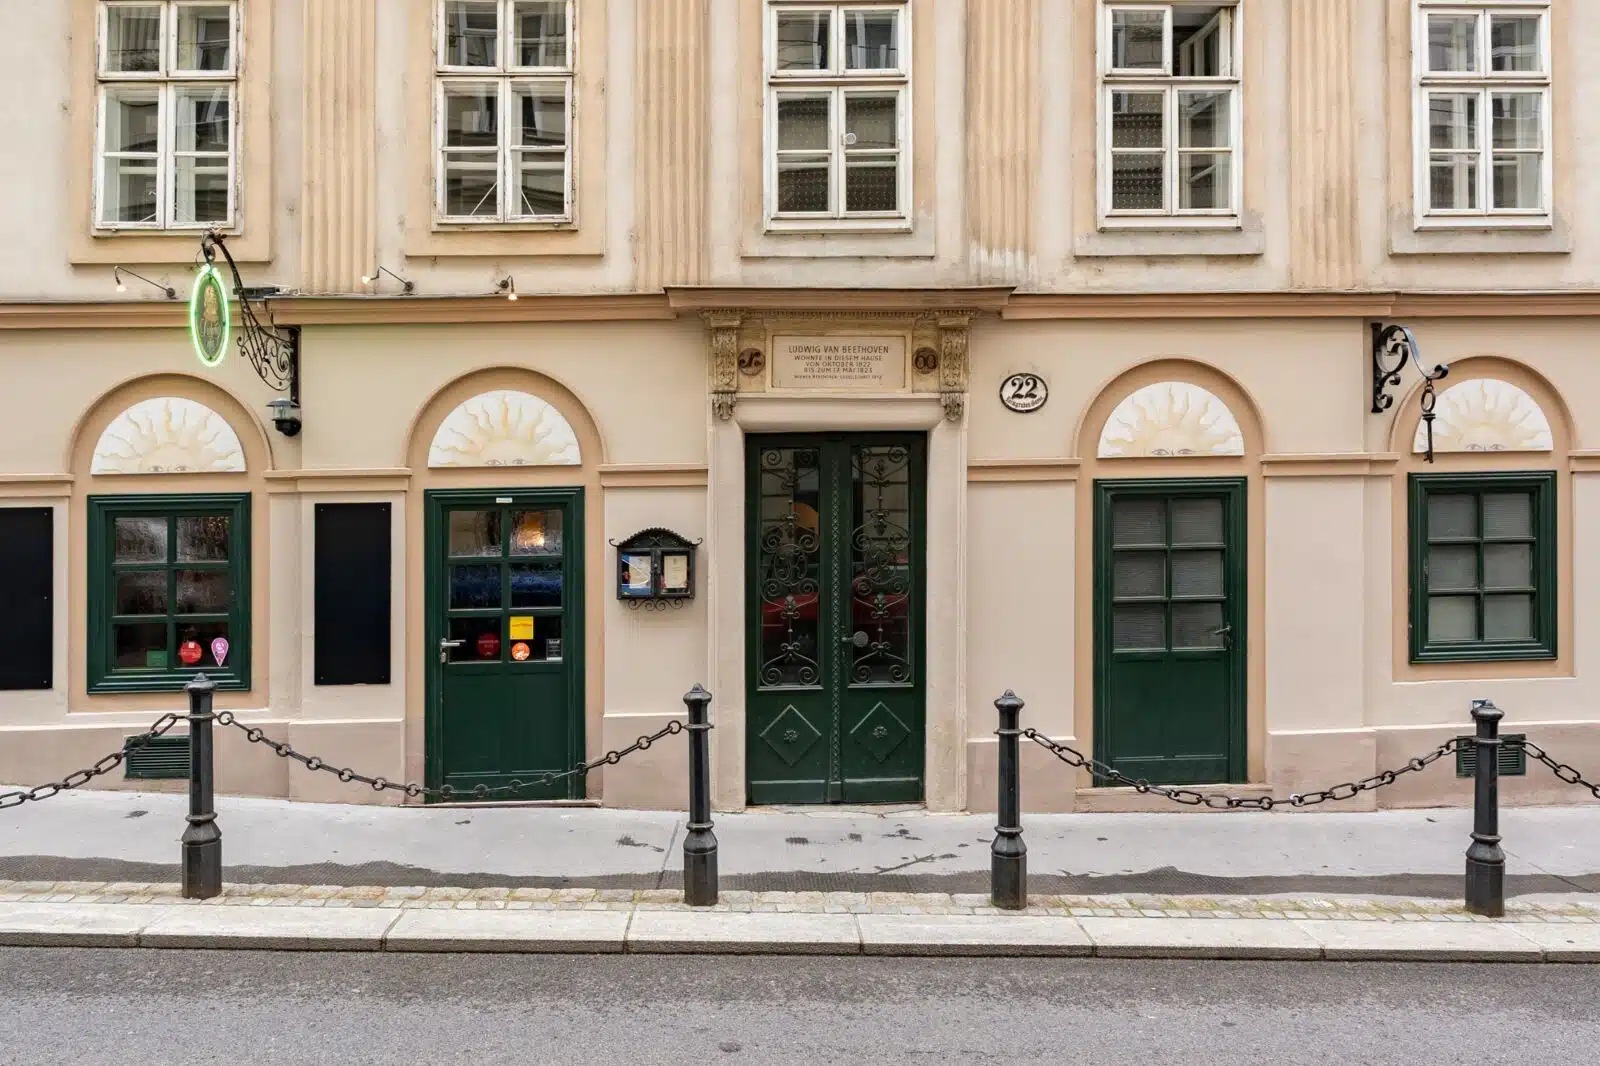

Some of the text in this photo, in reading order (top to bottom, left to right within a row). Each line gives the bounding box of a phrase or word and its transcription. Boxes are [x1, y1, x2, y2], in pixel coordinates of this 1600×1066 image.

[788, 345, 889, 354] LUDWIG VAN BEETHOVEN
[1011, 377, 1038, 399] 22
